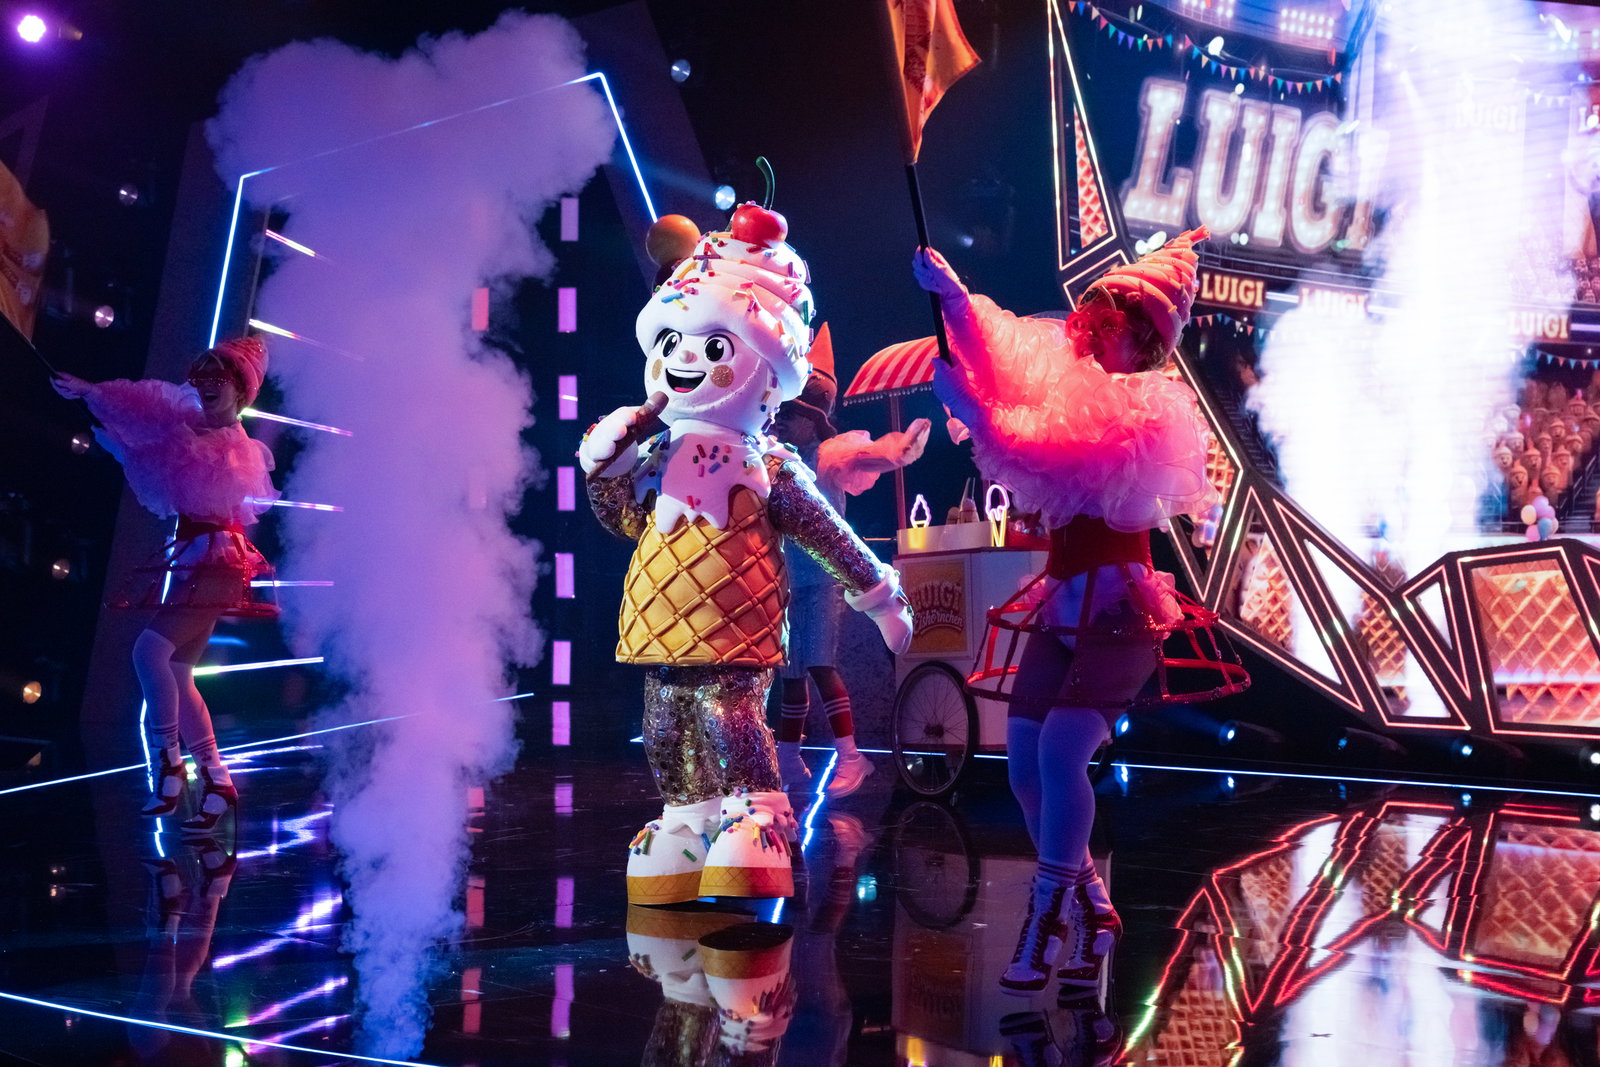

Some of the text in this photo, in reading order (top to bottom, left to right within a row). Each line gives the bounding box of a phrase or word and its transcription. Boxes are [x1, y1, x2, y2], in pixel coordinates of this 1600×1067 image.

[1122, 77, 1389, 253] LUIGI
[1201, 273, 1265, 307] LUIGI
[1507, 311, 1568, 339] LUIGI
